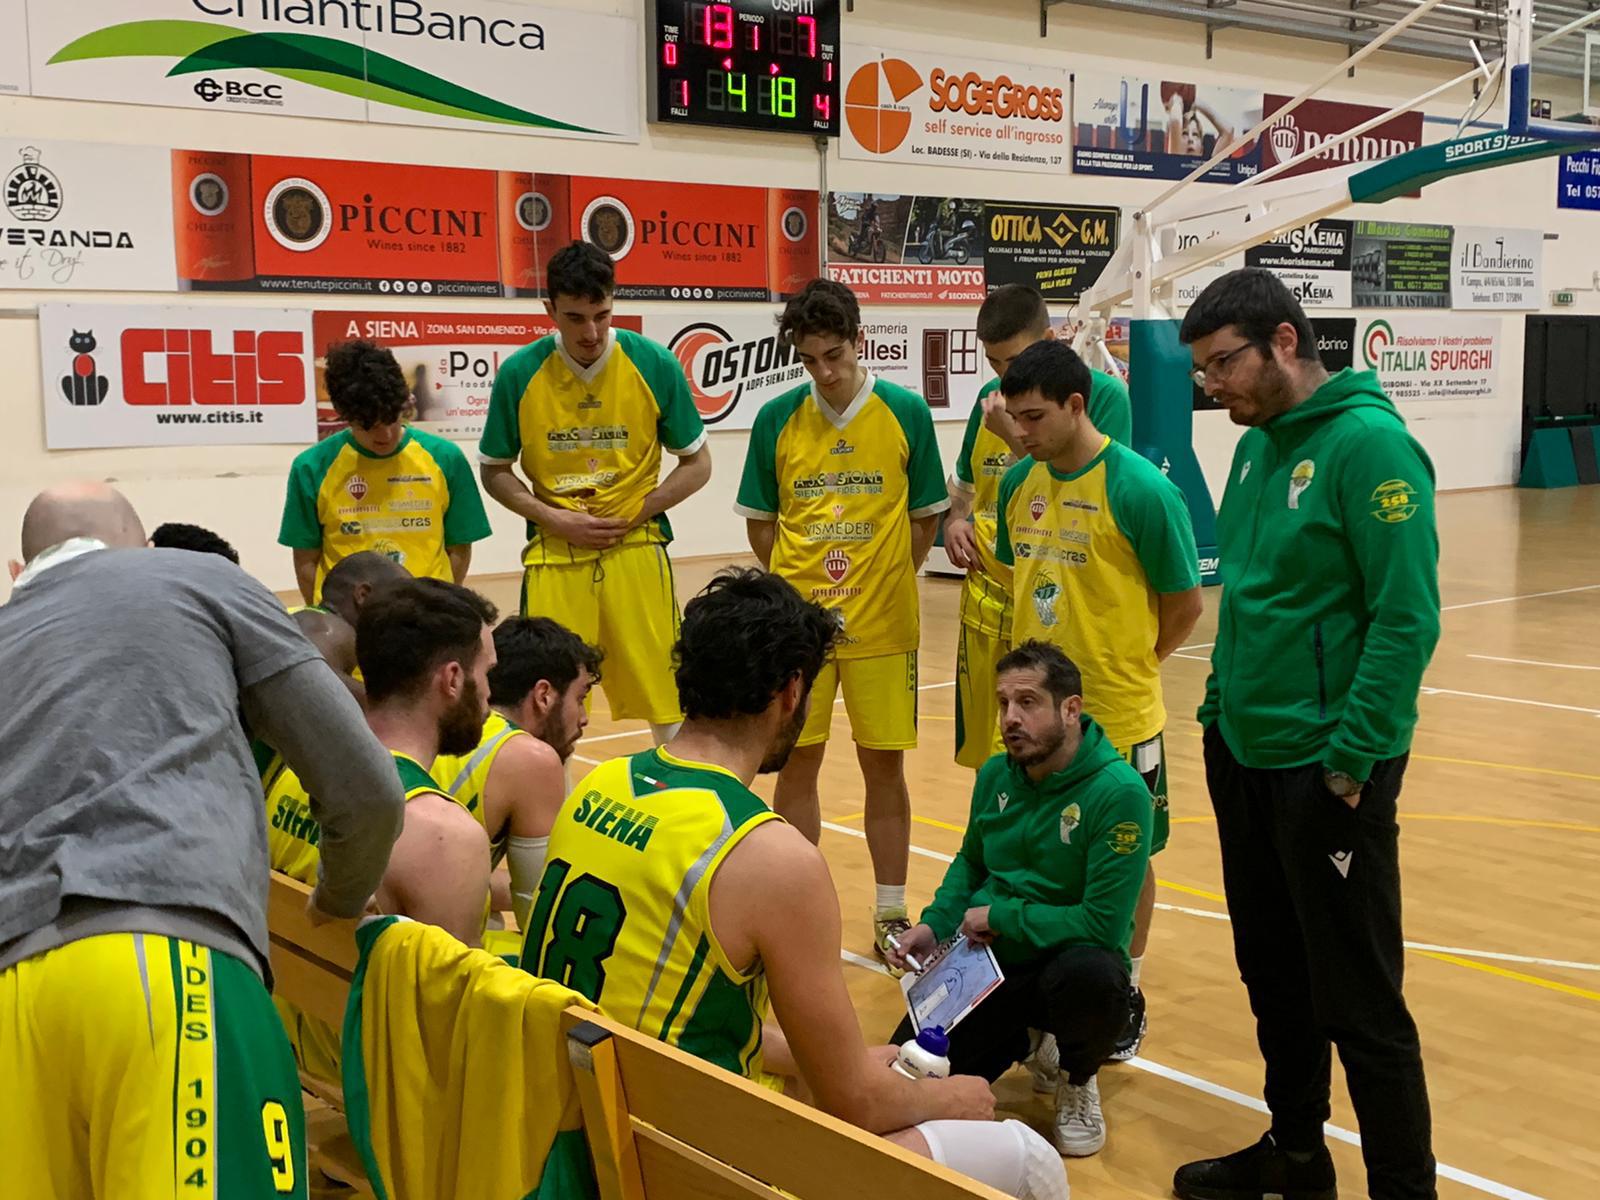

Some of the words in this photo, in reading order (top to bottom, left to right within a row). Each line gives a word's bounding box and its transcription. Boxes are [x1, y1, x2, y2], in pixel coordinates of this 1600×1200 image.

[738, 13, 764, 24] PERIODO
[664, 25, 679, 34] TIME
[704, 5, 733, 49] 13
[664, 34, 678, 42] OUT
[797, 16, 816, 58] 7
[664, 44, 676, 66] 0
[821, 44, 834, 53] TIME
[821, 52, 833, 61] OUT
[225, 80, 283, 100] BCC
[727, 72, 747, 113] 4
[771, 77, 796, 118] 18
[670, 107, 688, 117] FALLI
[815, 94, 830, 120] 4
[813, 120, 829, 129] FALLI
[925, 119, 946, 134] self
[950, 121, 992, 138] service
[995, 125, 1063, 145] all'ingrosso
[911, 145, 926, 156] Loc.
[927, 145, 958, 157] BADESSE
[979, 150, 991, 160] Via
[992, 150, 1010, 161] della
[1445, 138, 1492, 158] SPORT
[1237, 162, 1257, 177] Unipol
[1566, 155, 1590, 174] Pecchi
[1566, 184, 1581, 197] Tel
[990, 214, 1043, 243] OTTICA
[1080, 218, 1110, 246] G.M.
[0, 228, 134, 249] ERANDA
[366, 239, 404, 251] Wines
[408, 241, 436, 253] since
[440, 242, 466, 254] 1882
[662, 250, 691, 262] Wines
[695, 251, 717, 262] since
[721, 252, 742, 263] 1882
[1461, 243, 1469, 268] il
[1473, 238, 1534, 270] Bandierino
[1260, 257, 1334, 268] www.fuoriskema.net
[829, 267, 932, 286] FATICHENTI
[937, 269, 984, 286] MOTO
[260, 278, 373, 292] www.tenutepiccini.it
[437, 283, 497, 294] picciniwines
[717, 290, 766, 299] picciniwines
[948, 292, 985, 300] HONDA
[346, 320, 361, 338] A
[366, 320, 420, 339] SIENA
[427, 324, 454, 335] ZONA
[456, 324, 475, 335] SAN
[476, 325, 526, 335] DOMENICO
[532, 326, 547, 335] Via
[1396, 336, 1437, 347] Risolviamo
[1442, 335, 1462, 346] Vostri
[1463, 335, 1492, 347] problemi
[1380, 350, 1427, 372] ITALIA
[1430, 350, 1492, 371] SPURGHI
[765, 374, 785, 386] SIENA
[787, 366, 804, 381] 1989
[1446, 379, 1478, 387] Settembre
[156, 410, 264, 424] www.citis.it
[446, 407, 489, 417] un'esperi
[794, 488, 824, 499] SIENA
[837, 485, 861, 496] FIDES
[803, 522, 874, 536] VISMEDERI
[573, 789, 660, 852] SIENA
[520, 857, 628, 1004] 18
[185, 941, 208, 1042] IDES
[184, 1078, 208, 1189] 1904
[261, 1097, 296, 1195] 9
